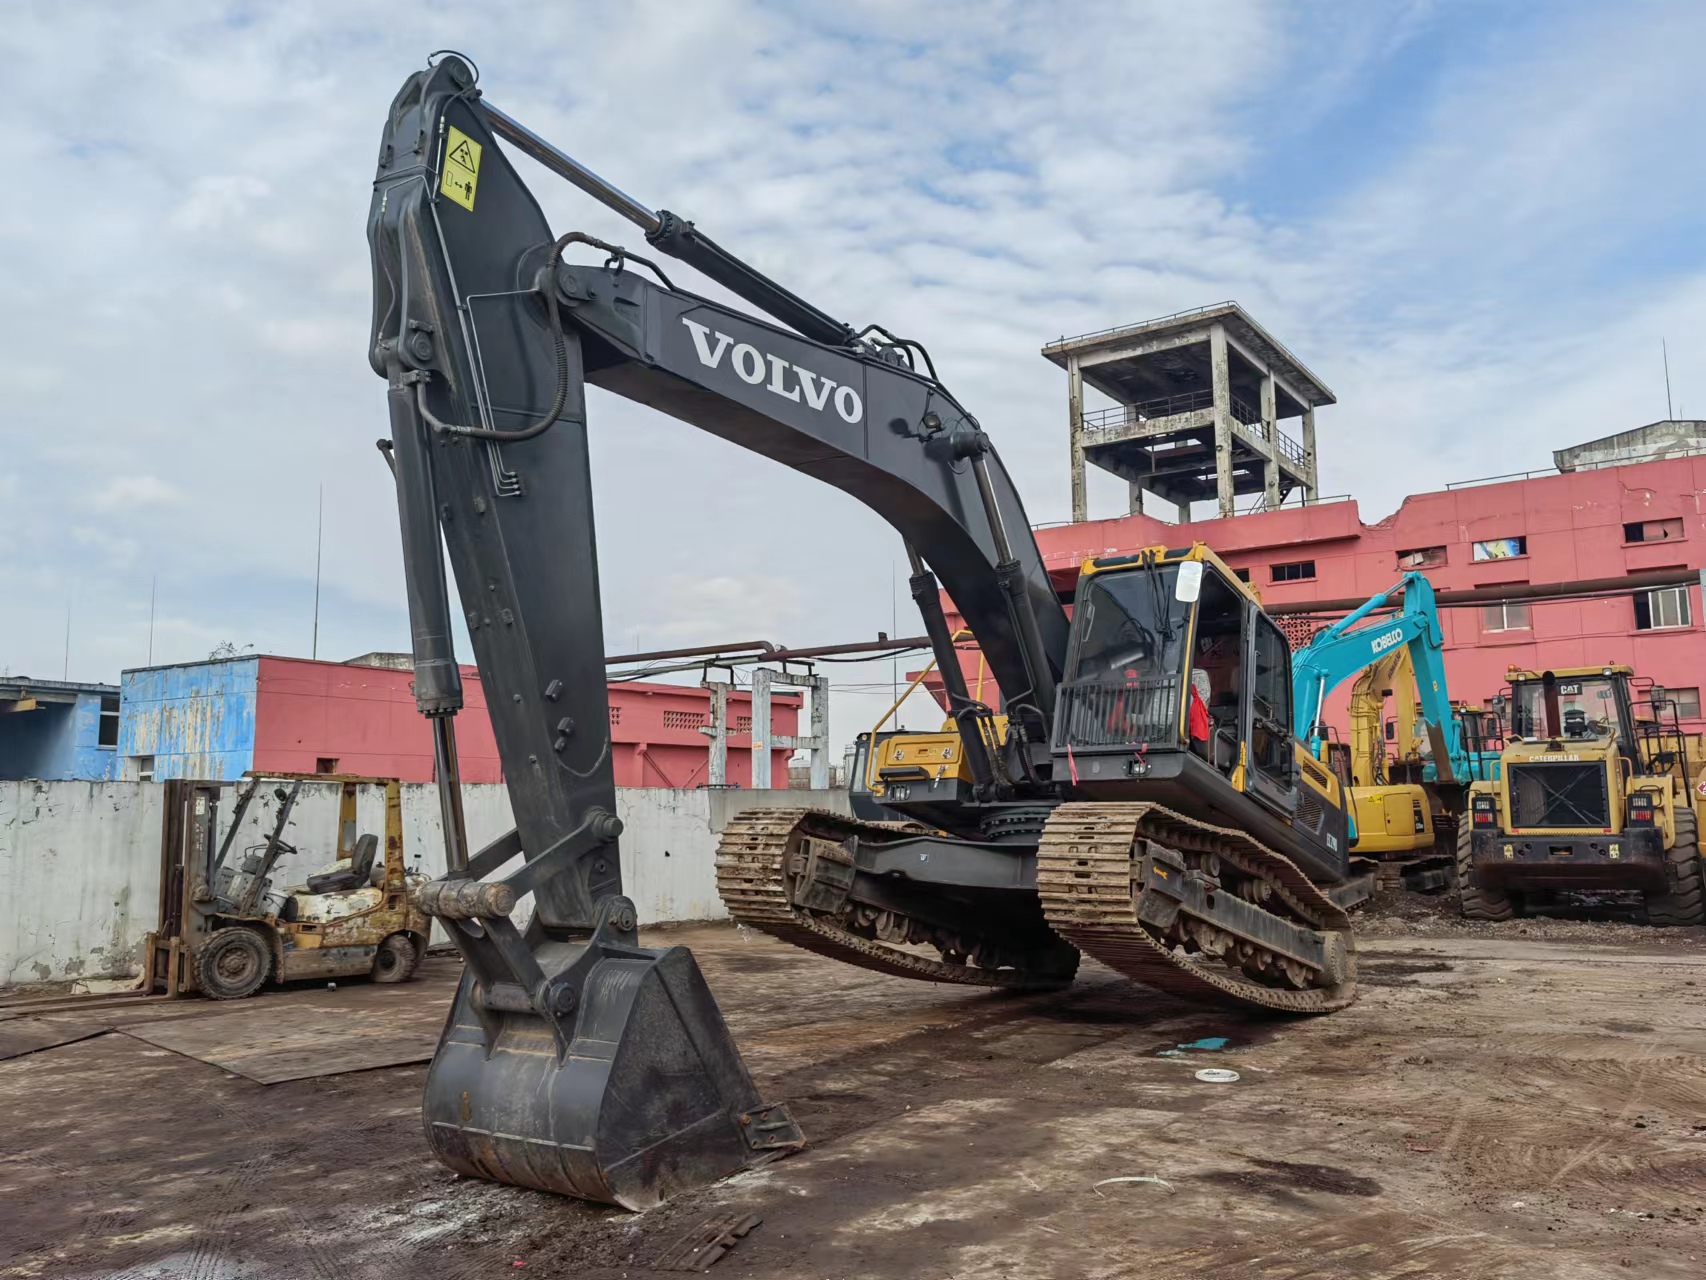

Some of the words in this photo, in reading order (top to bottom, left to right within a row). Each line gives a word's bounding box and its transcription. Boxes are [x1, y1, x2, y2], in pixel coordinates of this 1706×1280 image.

[682, 317, 863, 424] VOLVO
[1371, 628, 1403, 654] KOBELCO
[1560, 684, 1579, 695] CAT
[1529, 754, 1580, 762] CATERPILLAR
